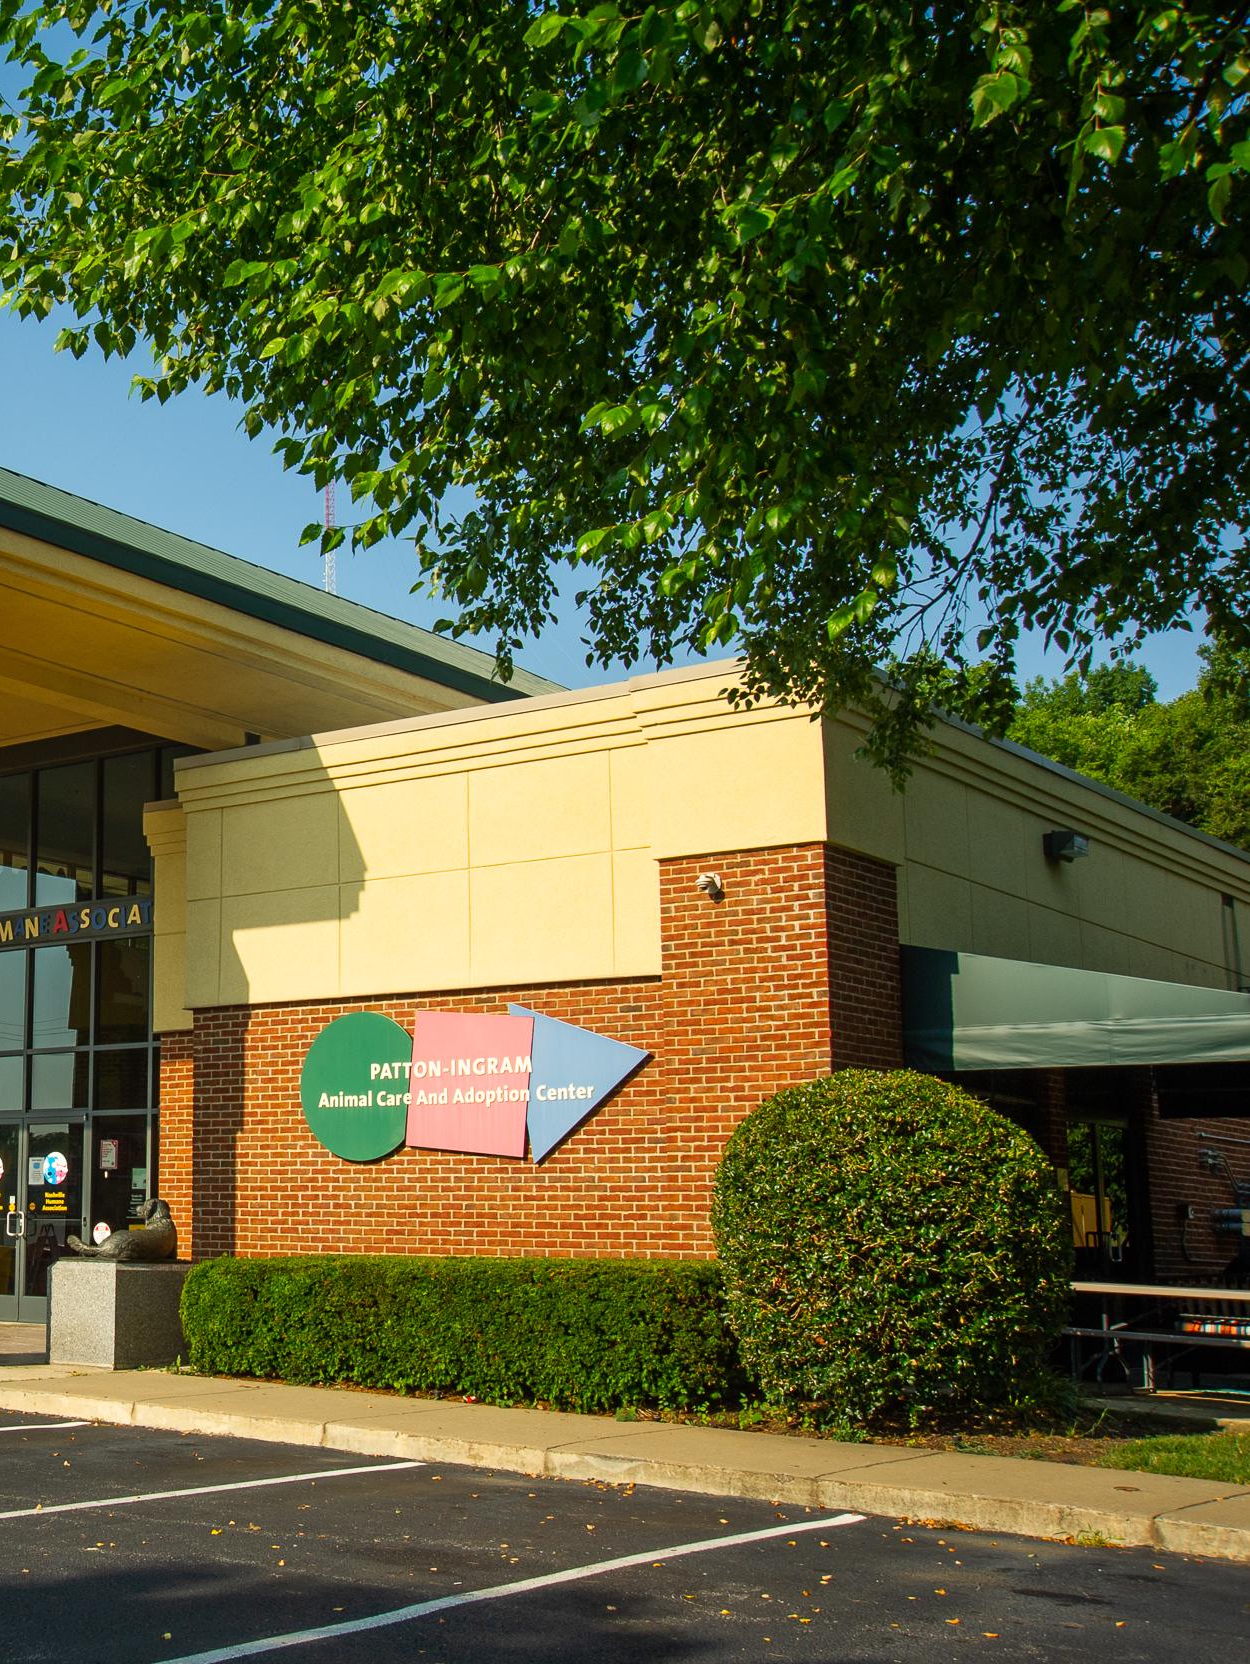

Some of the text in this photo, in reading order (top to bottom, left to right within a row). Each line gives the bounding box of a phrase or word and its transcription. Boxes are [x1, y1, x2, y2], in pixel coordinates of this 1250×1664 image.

[370, 1056, 532, 1080] PATTON-INGRAM
[318, 1083, 594, 1108] Animal Care And Adoption Center
